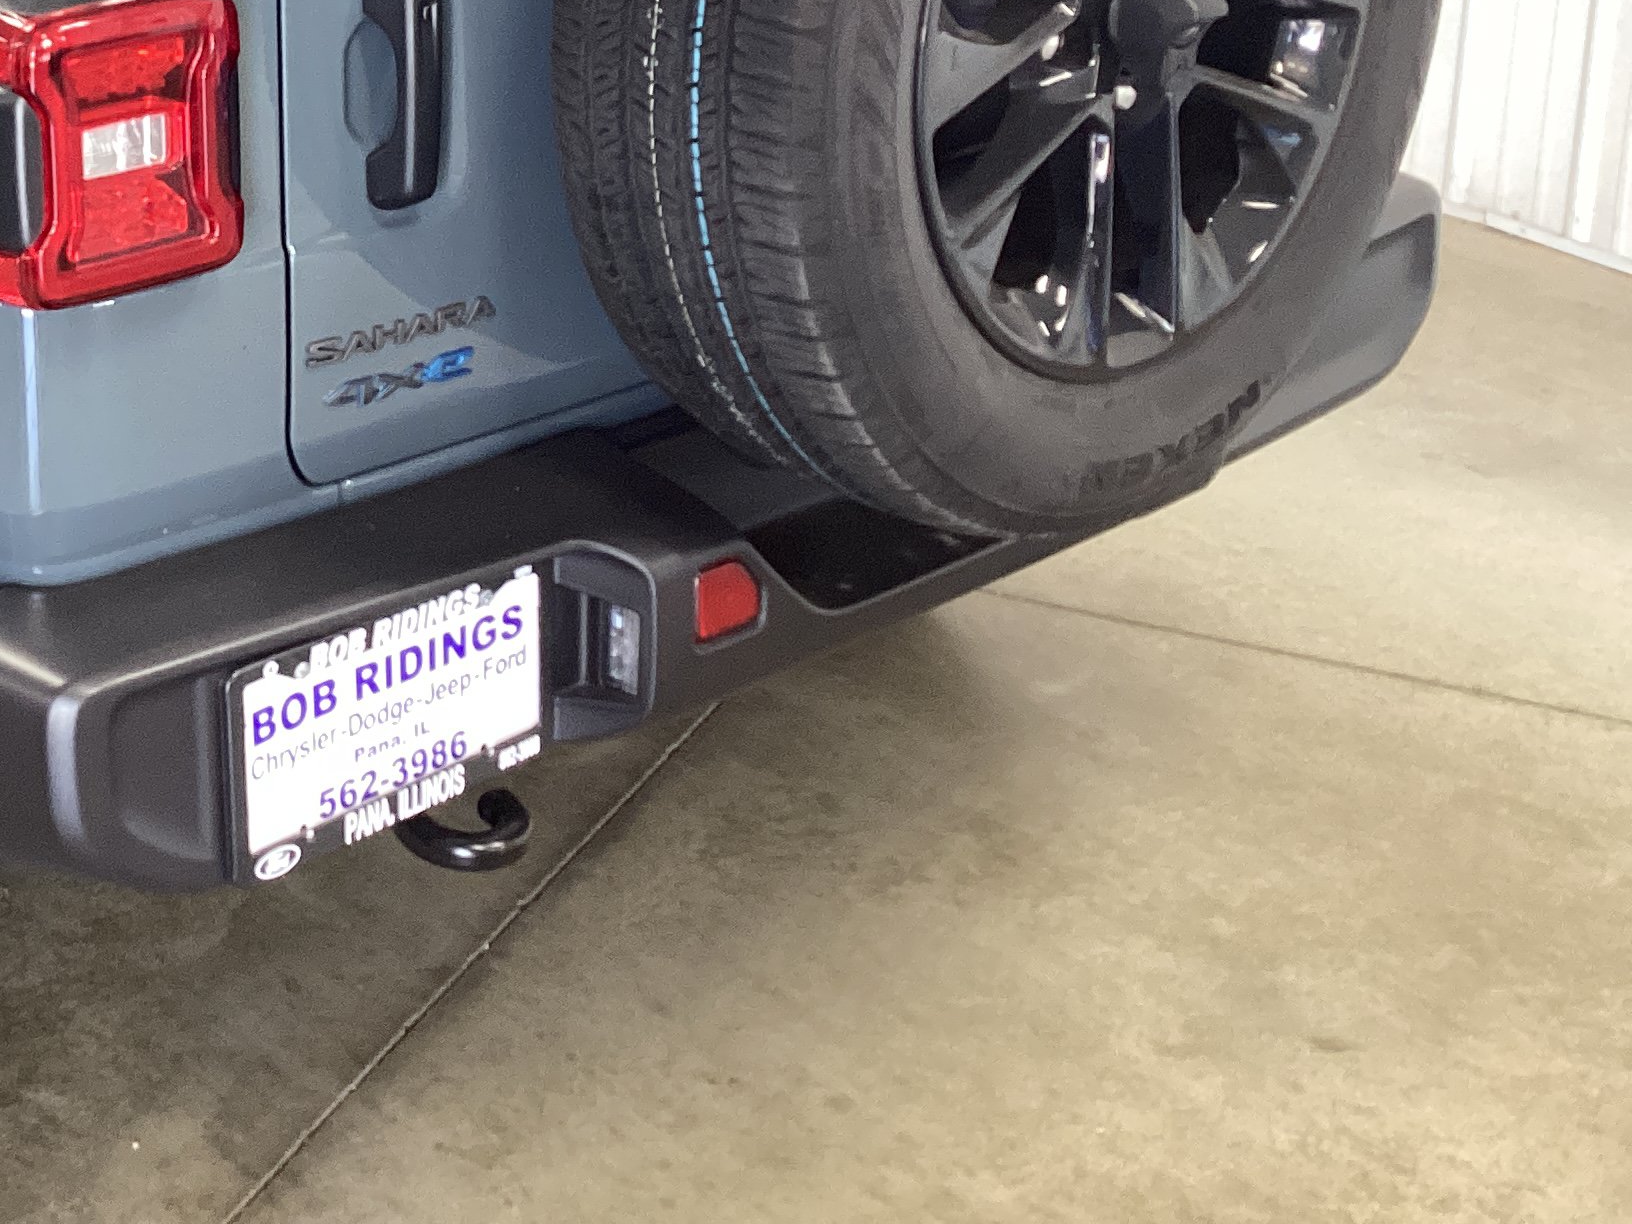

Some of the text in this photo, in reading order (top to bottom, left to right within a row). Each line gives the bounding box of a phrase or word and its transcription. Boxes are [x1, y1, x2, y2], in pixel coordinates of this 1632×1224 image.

[305, 295, 497, 368] SAHARA
[310, 582, 481, 671] BOB RIDINGS
[252, 605, 524, 746] BOB RIDINGS
[320, 730, 469, 820] 562-3986
[397, 764, 466, 822] ILLINOIS
